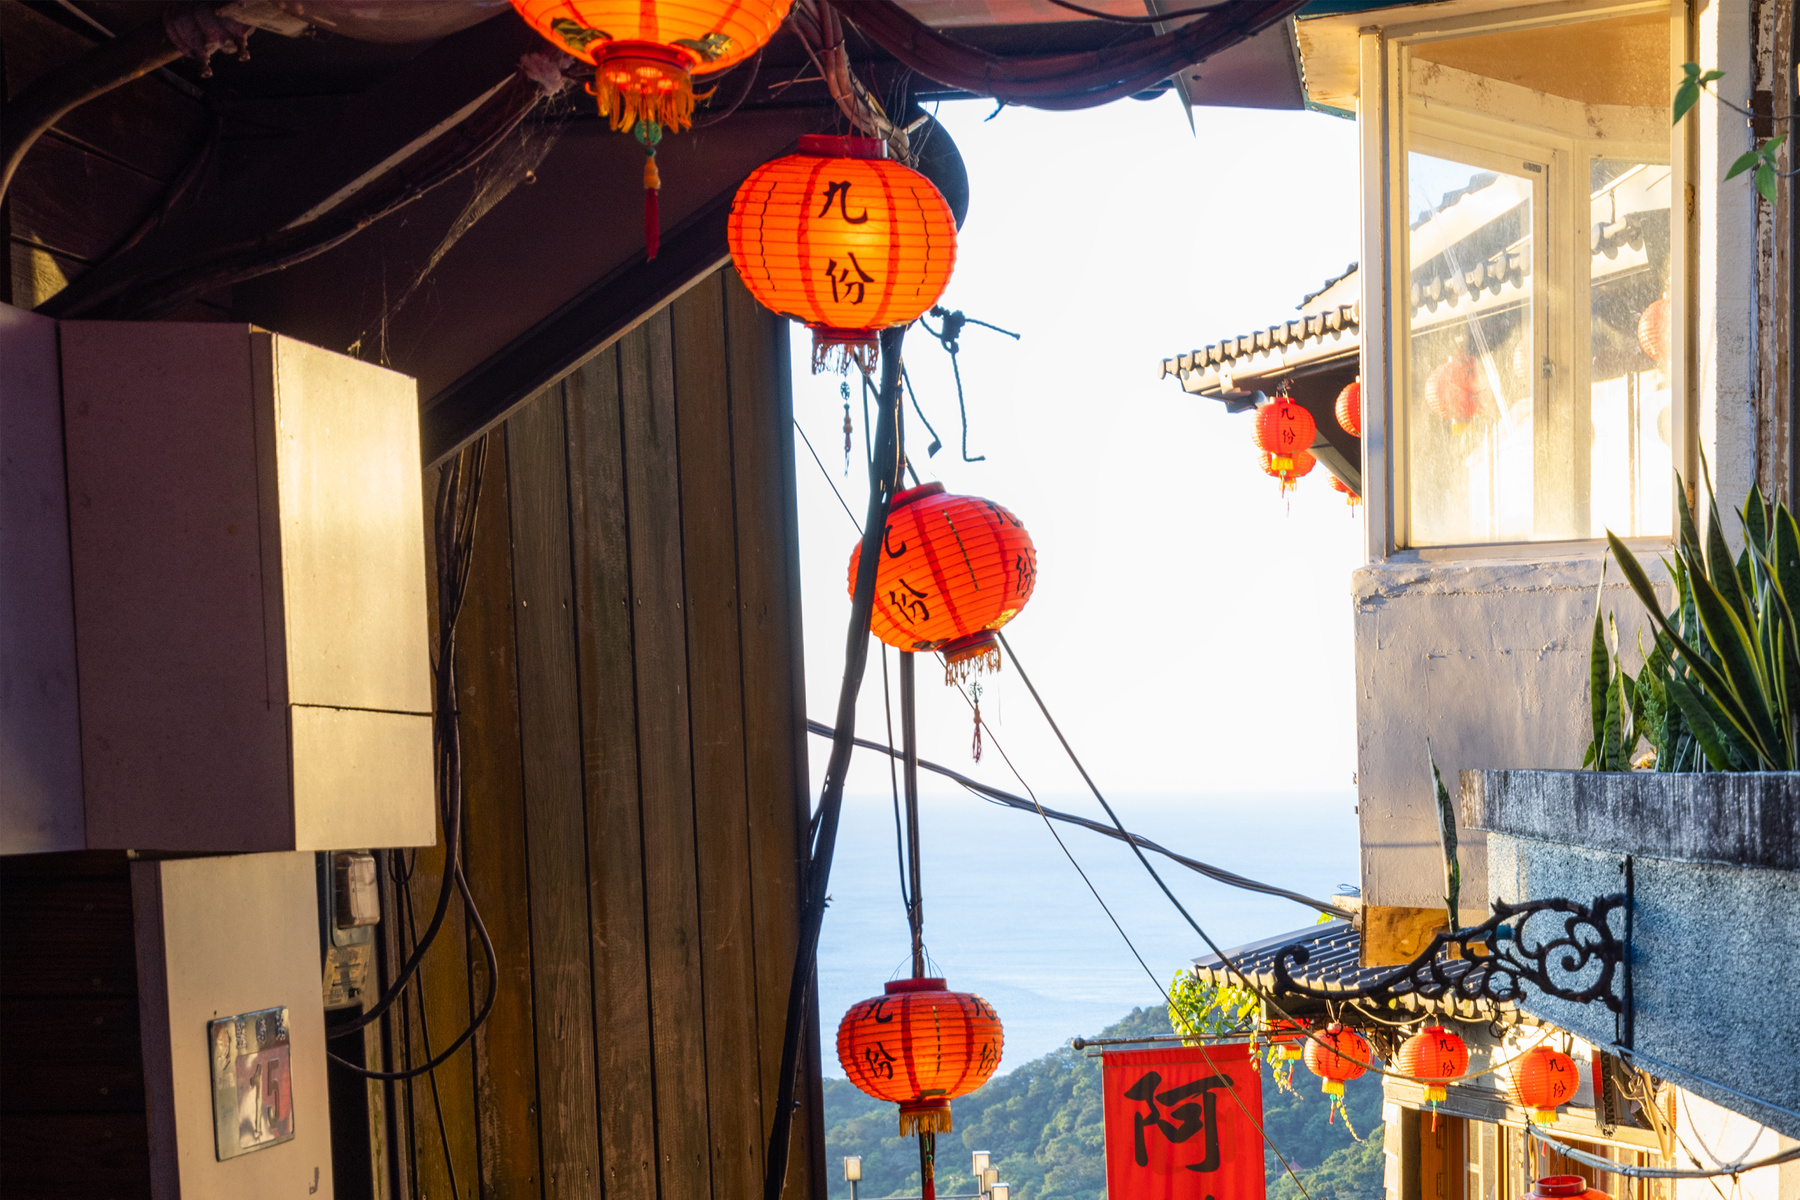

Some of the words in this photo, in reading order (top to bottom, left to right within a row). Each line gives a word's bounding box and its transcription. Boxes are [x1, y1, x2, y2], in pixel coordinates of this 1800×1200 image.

[818, 180, 874, 305] 九份
[1280, 406, 1297, 446] 九份
[862, 997, 897, 1080] 九份
[1438, 1038, 1456, 1078] 九份
[250, 1058, 281, 1139] 15
[1548, 1057, 1567, 1098] 九份
